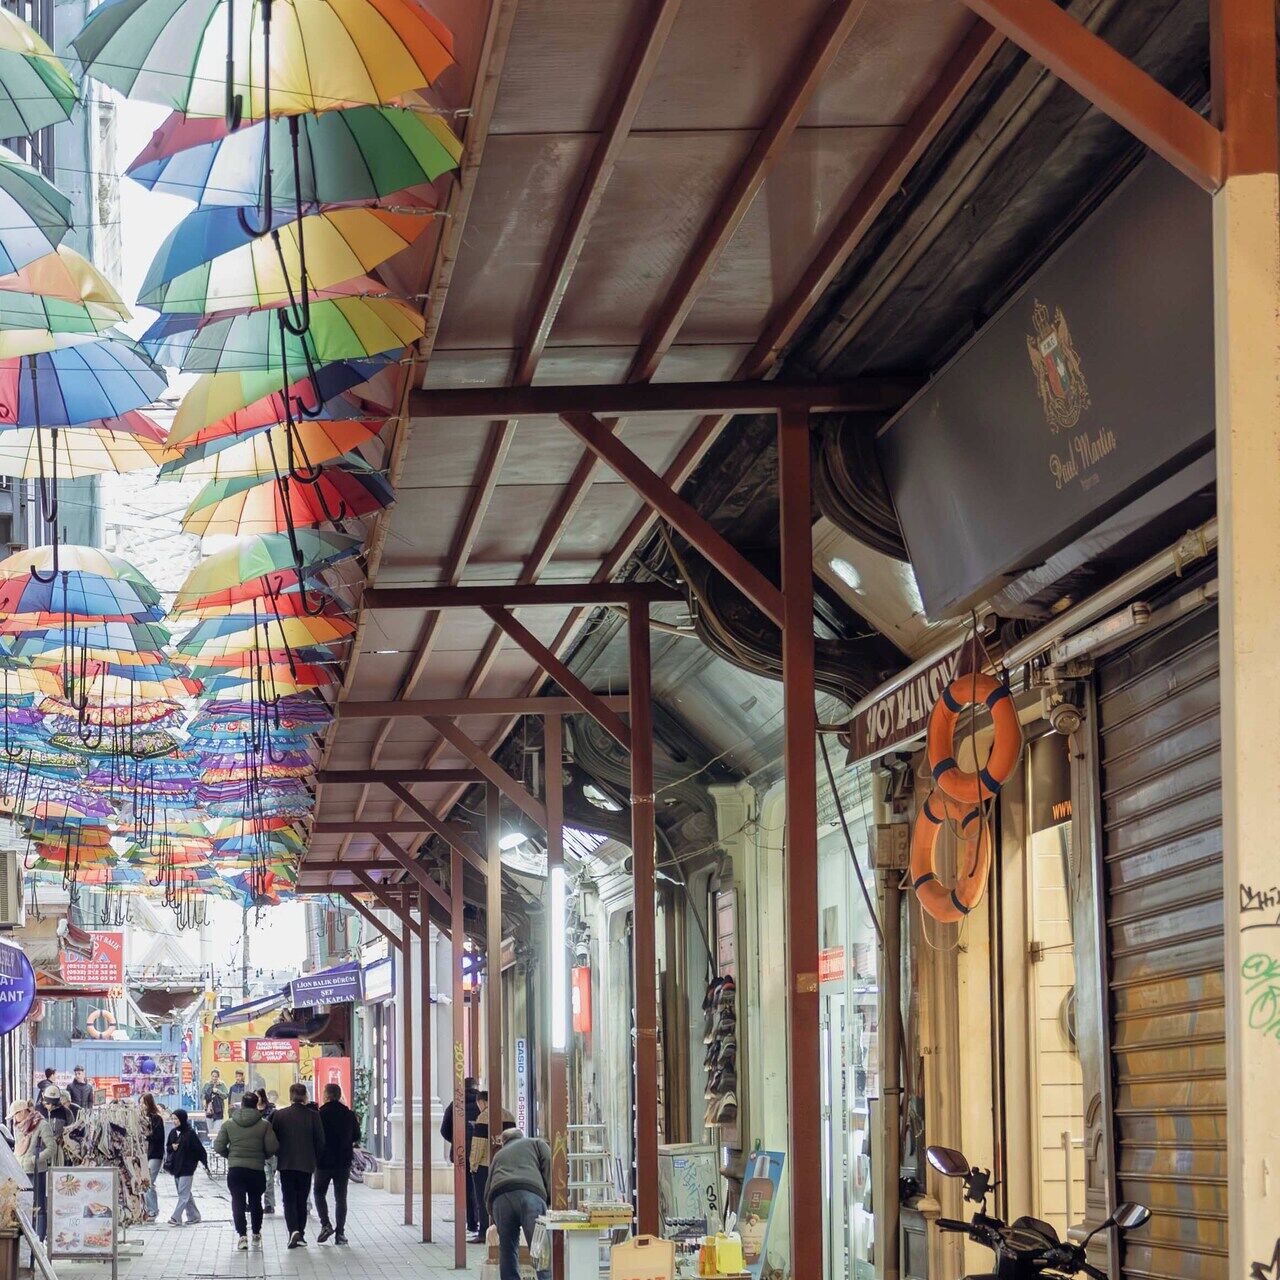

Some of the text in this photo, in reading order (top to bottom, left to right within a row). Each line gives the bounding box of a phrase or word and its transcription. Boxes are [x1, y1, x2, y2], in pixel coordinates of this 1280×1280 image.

[1050, 440, 1078, 489] Paul
[1074, 426, 1116, 470] Martin
[313, 978, 332, 987] BALIK
[302, 994, 355, 1007] ASLAN KAPLAN
[517, 1040, 525, 1074] CASIO
